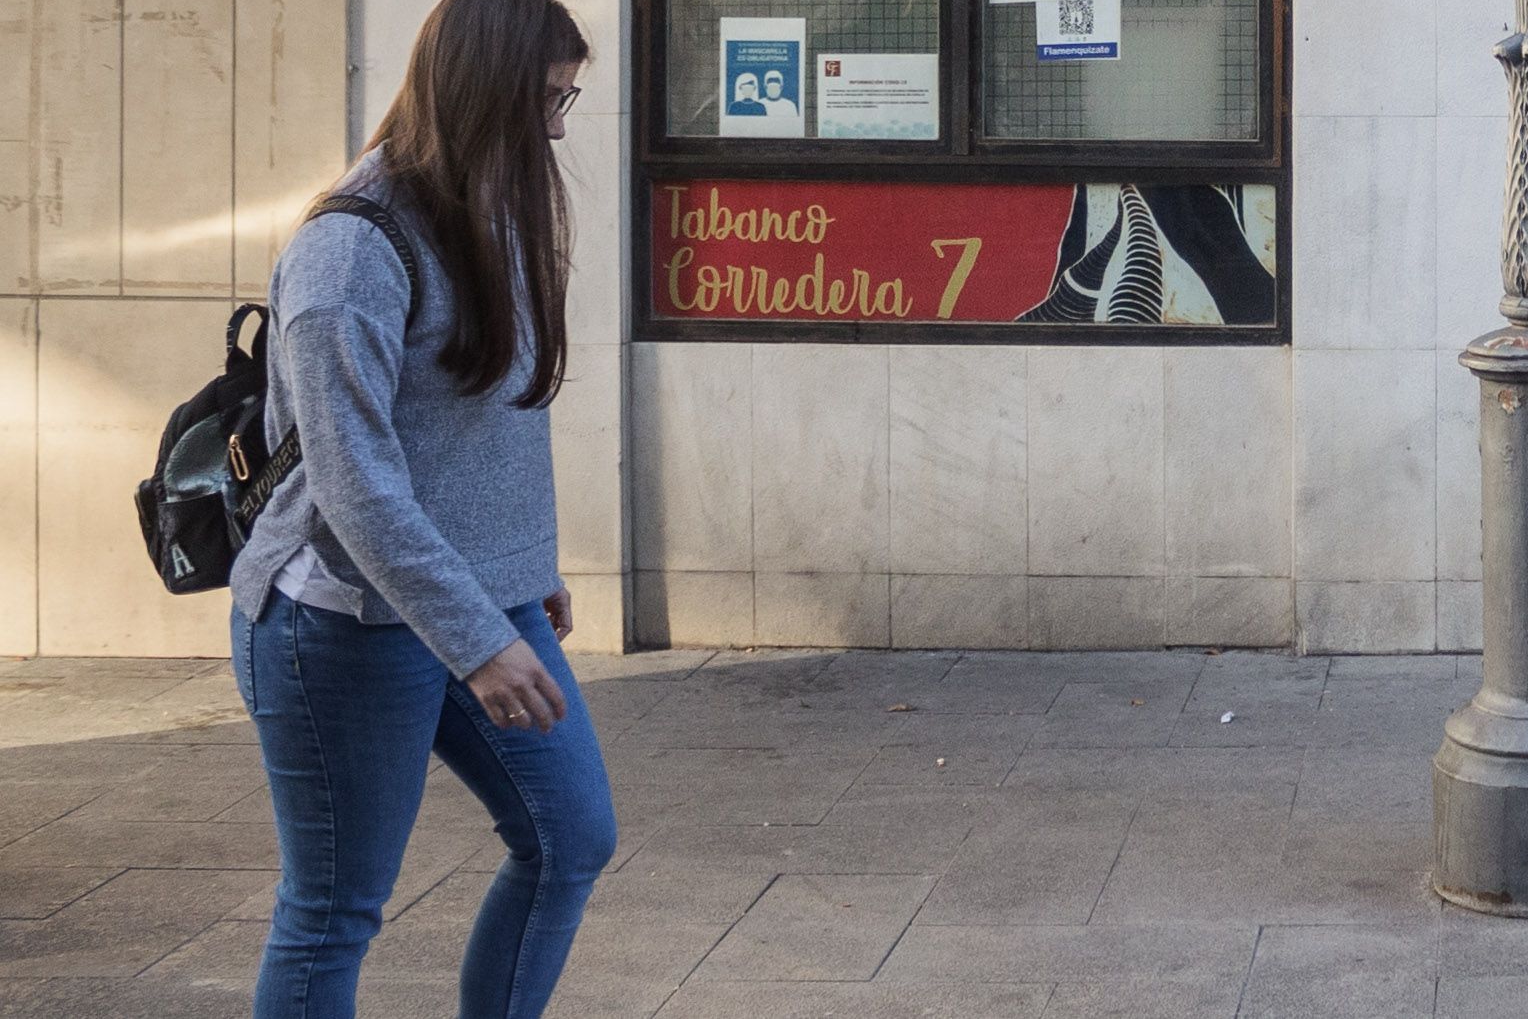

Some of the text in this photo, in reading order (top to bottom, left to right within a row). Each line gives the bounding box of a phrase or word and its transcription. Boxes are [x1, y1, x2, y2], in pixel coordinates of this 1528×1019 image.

[664, 186, 836, 244] Tabanco
[663, 237, 982, 319] Corredera 7
[169, 543, 195, 579] A
